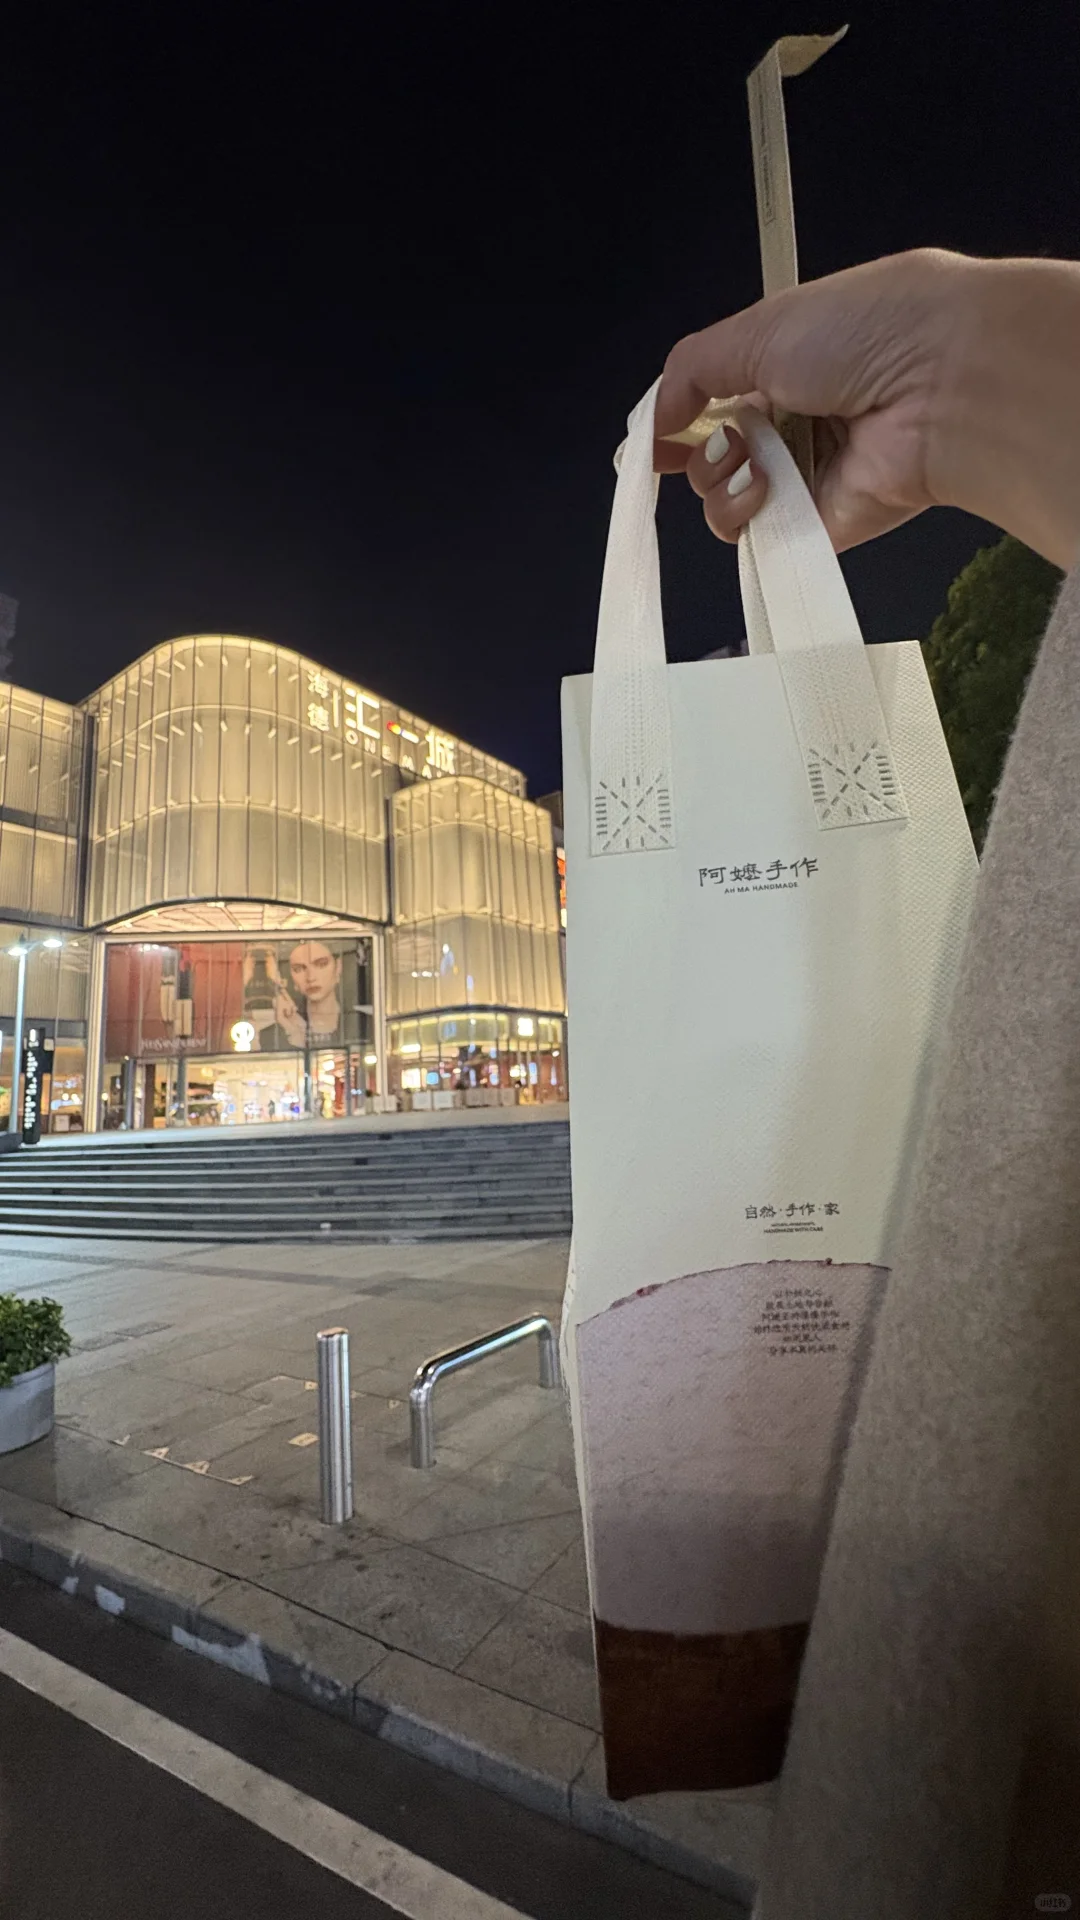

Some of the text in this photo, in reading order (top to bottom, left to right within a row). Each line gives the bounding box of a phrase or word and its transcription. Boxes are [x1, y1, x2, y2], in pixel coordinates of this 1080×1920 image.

[345, 687, 455, 774] 汇一城
[752, 881, 799, 891] HANDMADE
